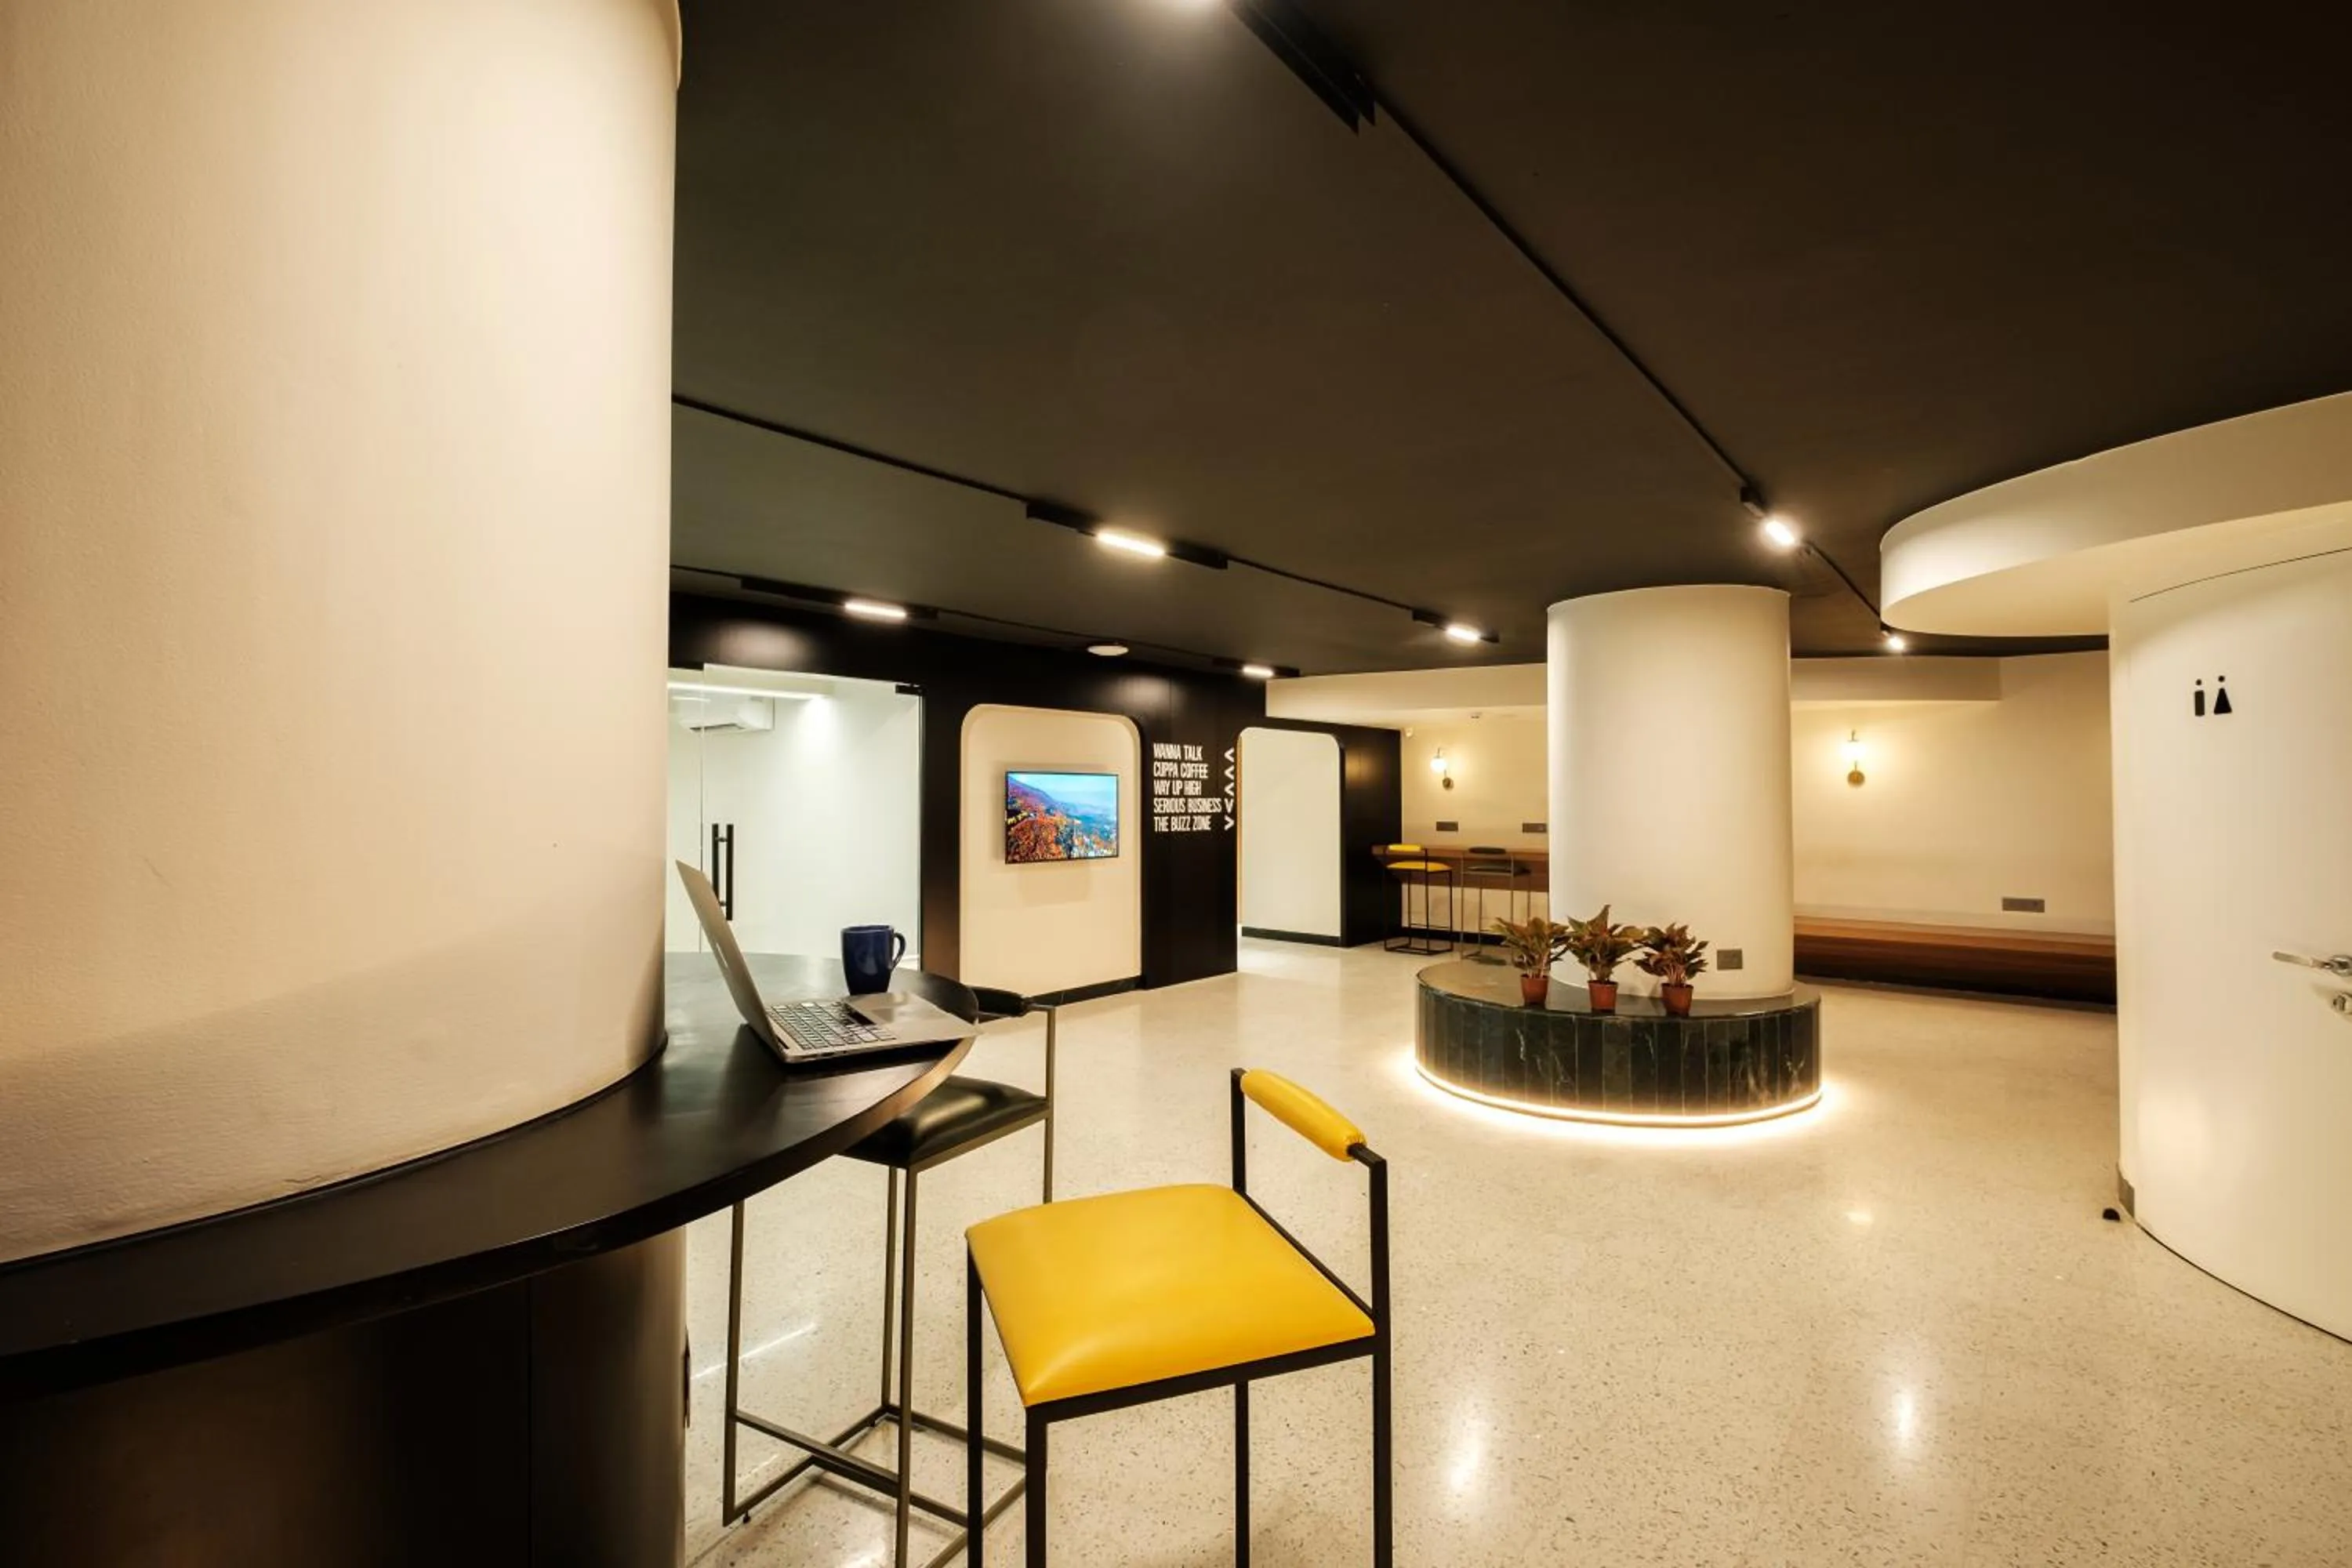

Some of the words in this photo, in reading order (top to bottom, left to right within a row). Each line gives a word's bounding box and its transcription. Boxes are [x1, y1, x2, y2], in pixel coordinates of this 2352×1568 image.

[1153, 742, 1181, 760] WANNA
[1184, 745, 1203, 760] TALK
[1153, 761, 1178, 778] CUPPA
[1181, 763, 1208, 779] COFFEE
[1153, 780, 1170, 795] WAY
[1172, 780, 1182, 795] UP
[1184, 780, 1202, 795] HIGH
[1153, 797, 1185, 813] SERIOUS
[1188, 797, 1221, 813] BUSINESS
[1154, 816, 1168, 832] THE
[1171, 816, 1190, 832] BUZZ
[1192, 815, 1211, 831] ZONE
